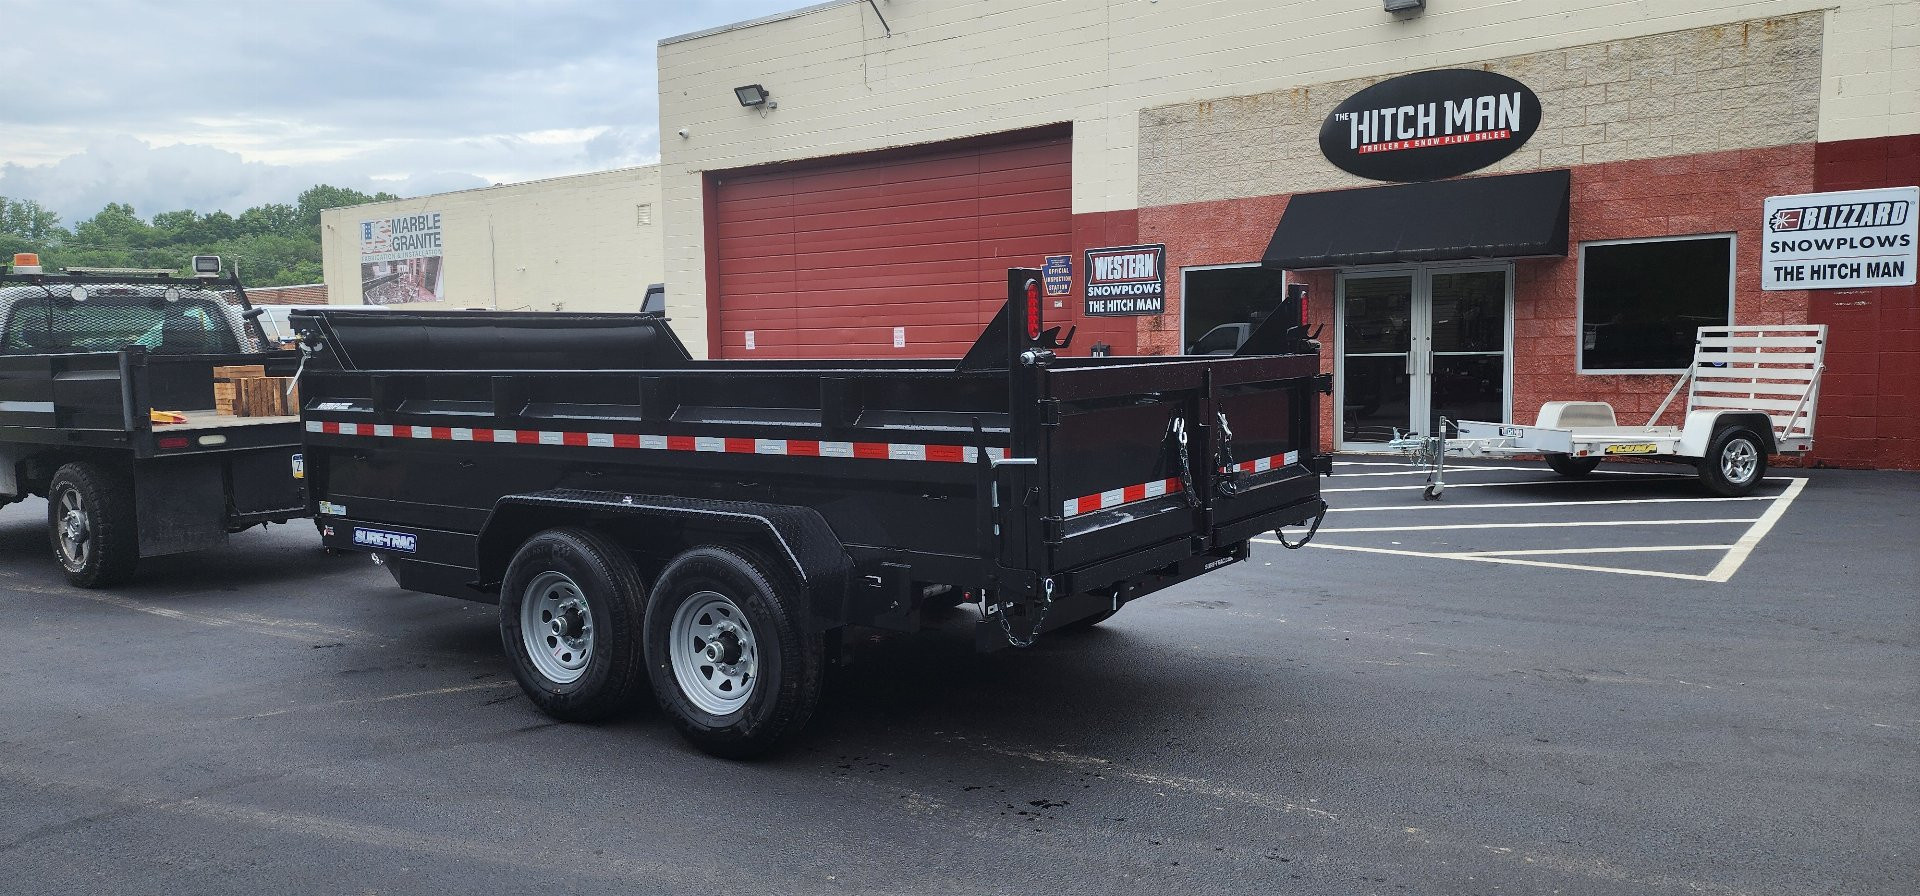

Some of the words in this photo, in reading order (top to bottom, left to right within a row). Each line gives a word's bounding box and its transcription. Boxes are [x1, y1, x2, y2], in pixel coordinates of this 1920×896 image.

[1335, 112, 1350, 122] THE
[1349, 102, 1436, 150] HITCH
[1443, 91, 1521, 135] MAN
[1362, 141, 1399, 153] TRAILER
[1414, 136, 1440, 147] SNOW
[1444, 133, 1470, 144] PLOW
[1475, 130, 1506, 141] SALES
[391, 213, 441, 234] MARBLE
[1801, 201, 1908, 230] BLIZZARD
[392, 232, 442, 251] GRANITE
[1770, 234, 1911, 254] SNOWPLOWS
[361, 253, 396, 262] FABRICATION
[1094, 253, 1154, 281] WESTERN
[1774, 265, 1805, 282] THE
[1810, 262, 1861, 281] HITCH
[1866, 261, 1905, 278] MAN
[1087, 283, 1162, 297] SNOWPLOWS
[1088, 300, 1105, 313] THE
[1106, 298, 1134, 312] HITCH
[1136, 297, 1161, 311] MAN
[1605, 443, 1657, 454] ALUMA
[354, 529, 415, 550] SURE-TRAC
